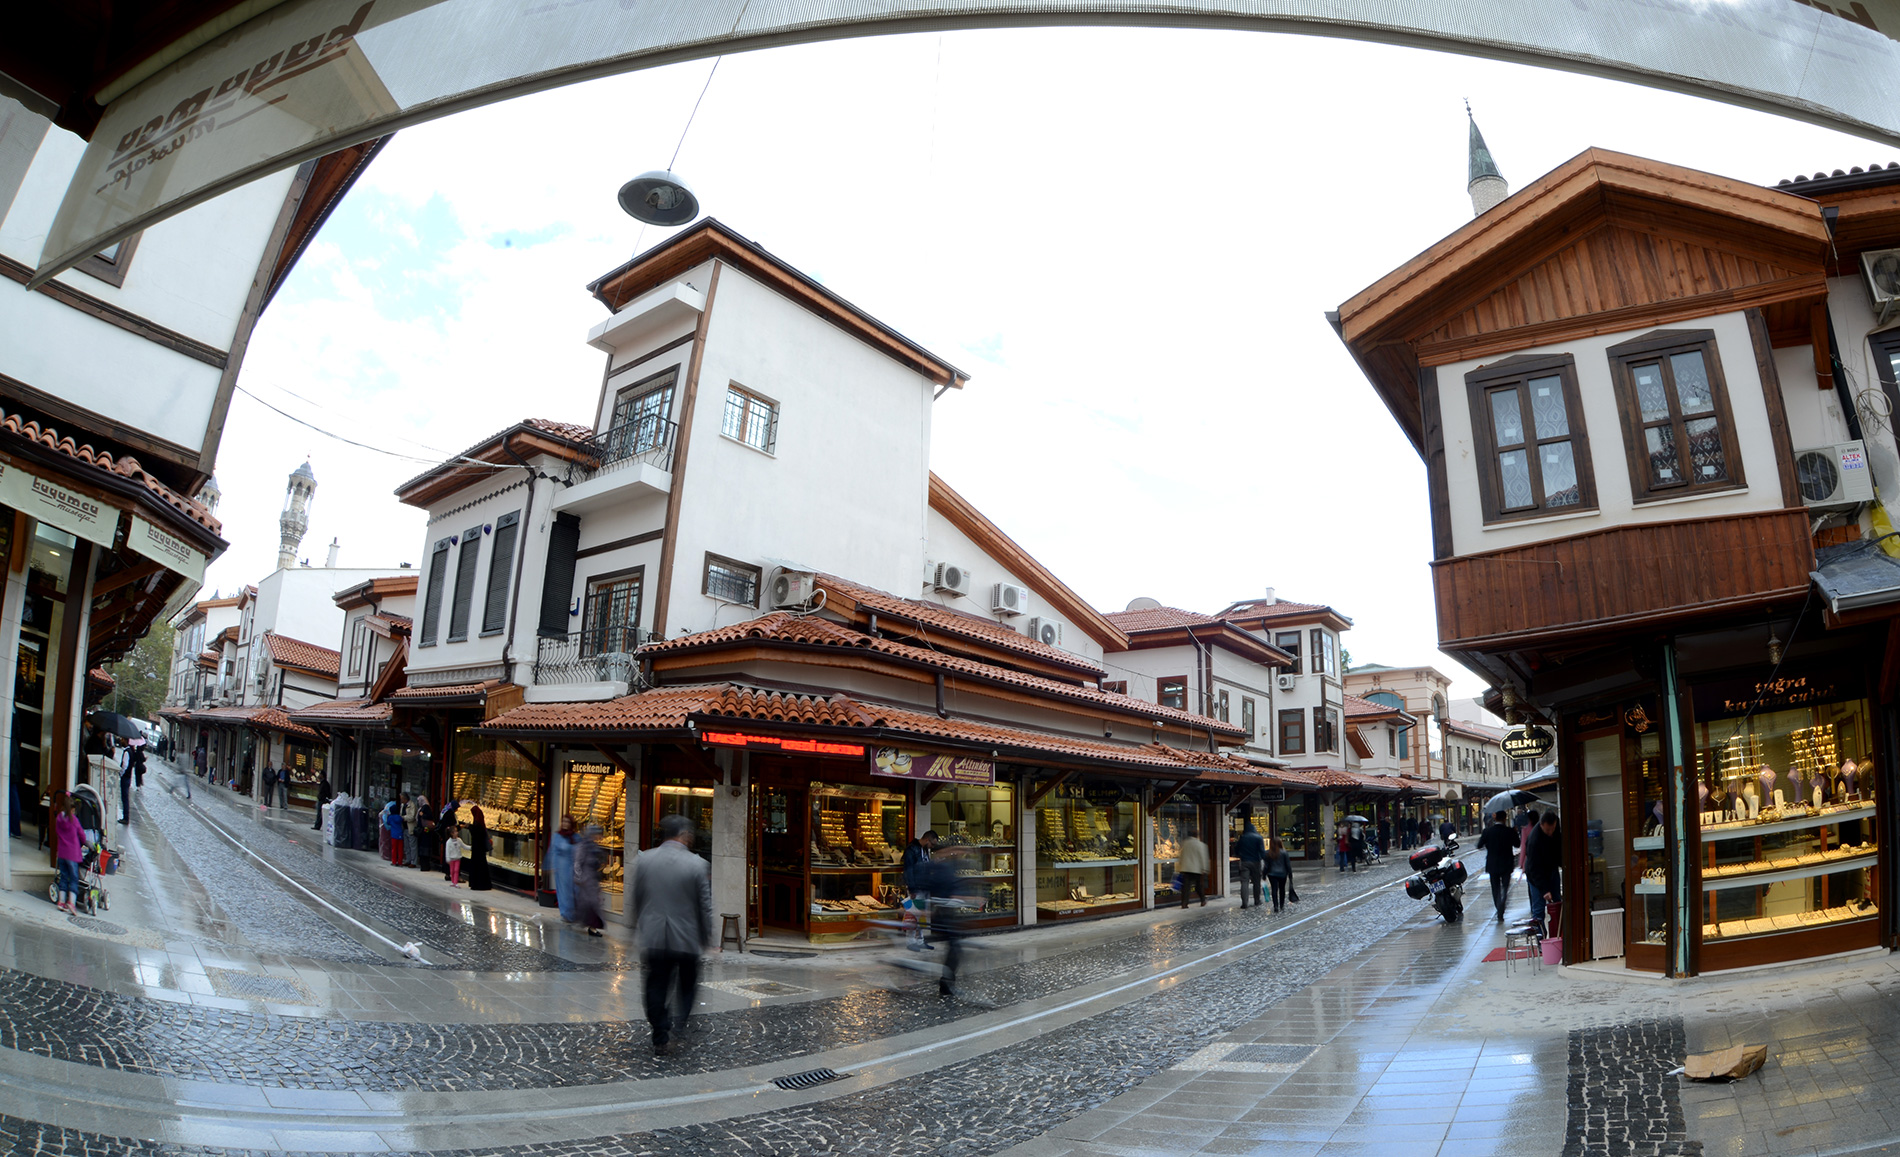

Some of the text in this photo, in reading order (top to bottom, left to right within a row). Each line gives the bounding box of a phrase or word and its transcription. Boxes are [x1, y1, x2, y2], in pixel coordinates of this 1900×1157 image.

[32, 475, 99, 515] kuyumcu
[56, 503, 91, 522] mustafa
[147, 524, 191, 557] kuyumcu
[164, 547, 187, 564] mustafa
[1755, 677, 1807, 695] tuğra
[1505, 737, 1549, 750] SELMAN
[1037, 876, 1066, 889] ELMAN
